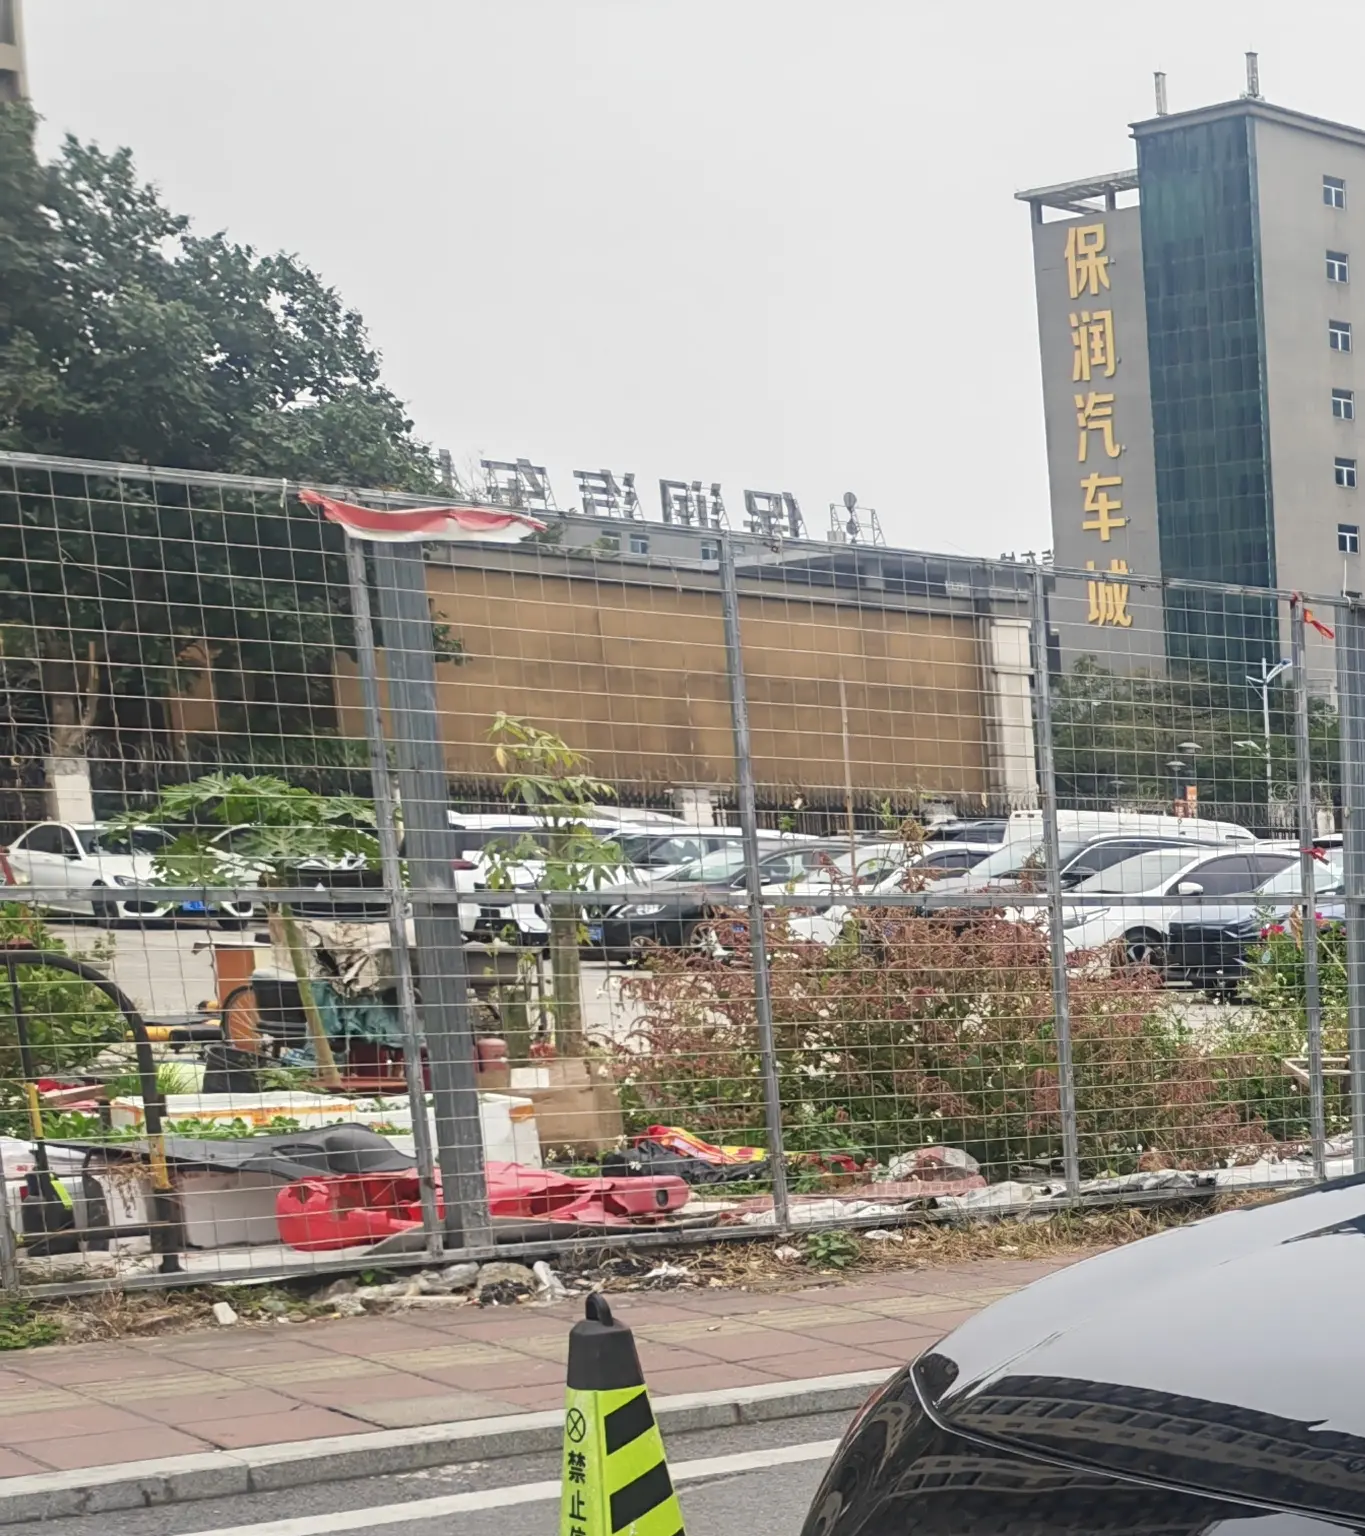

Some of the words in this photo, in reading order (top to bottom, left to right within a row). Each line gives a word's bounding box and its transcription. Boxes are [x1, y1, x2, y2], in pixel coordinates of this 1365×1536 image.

[1064, 222, 1133, 628] 保润汽车城
